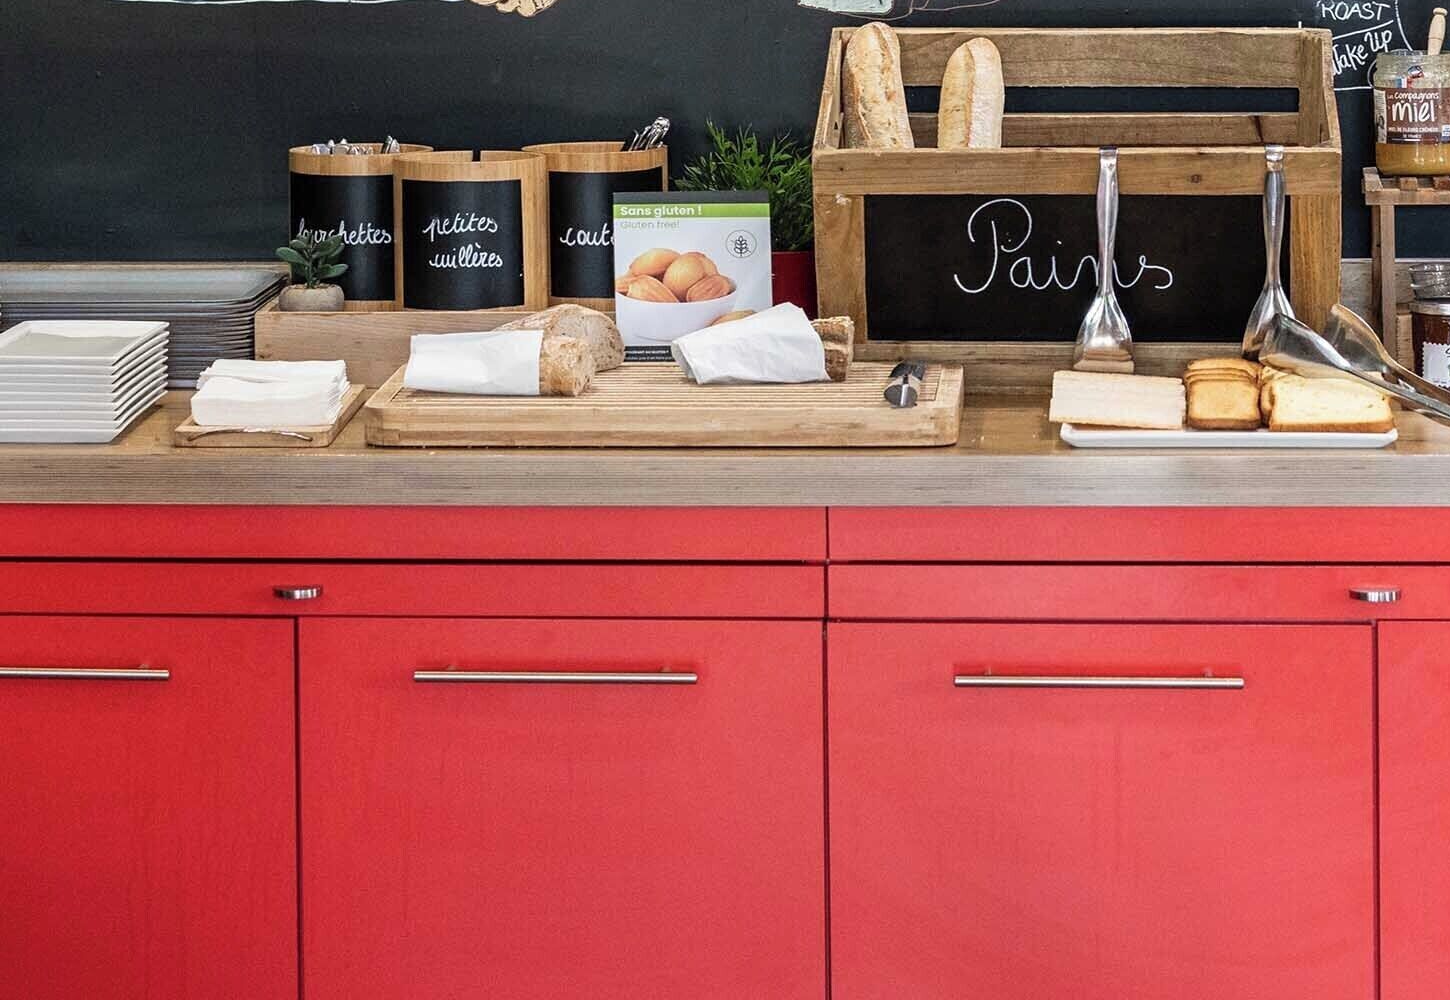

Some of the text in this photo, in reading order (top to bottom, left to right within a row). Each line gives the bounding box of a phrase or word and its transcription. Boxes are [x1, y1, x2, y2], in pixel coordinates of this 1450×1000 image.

[620, 206, 652, 216] Sans
[653, 205, 695, 218] gluten
[422, 212, 499, 243] petites
[620, 220, 680, 229] Gluten free!
[953, 198, 1174, 294] Pains
